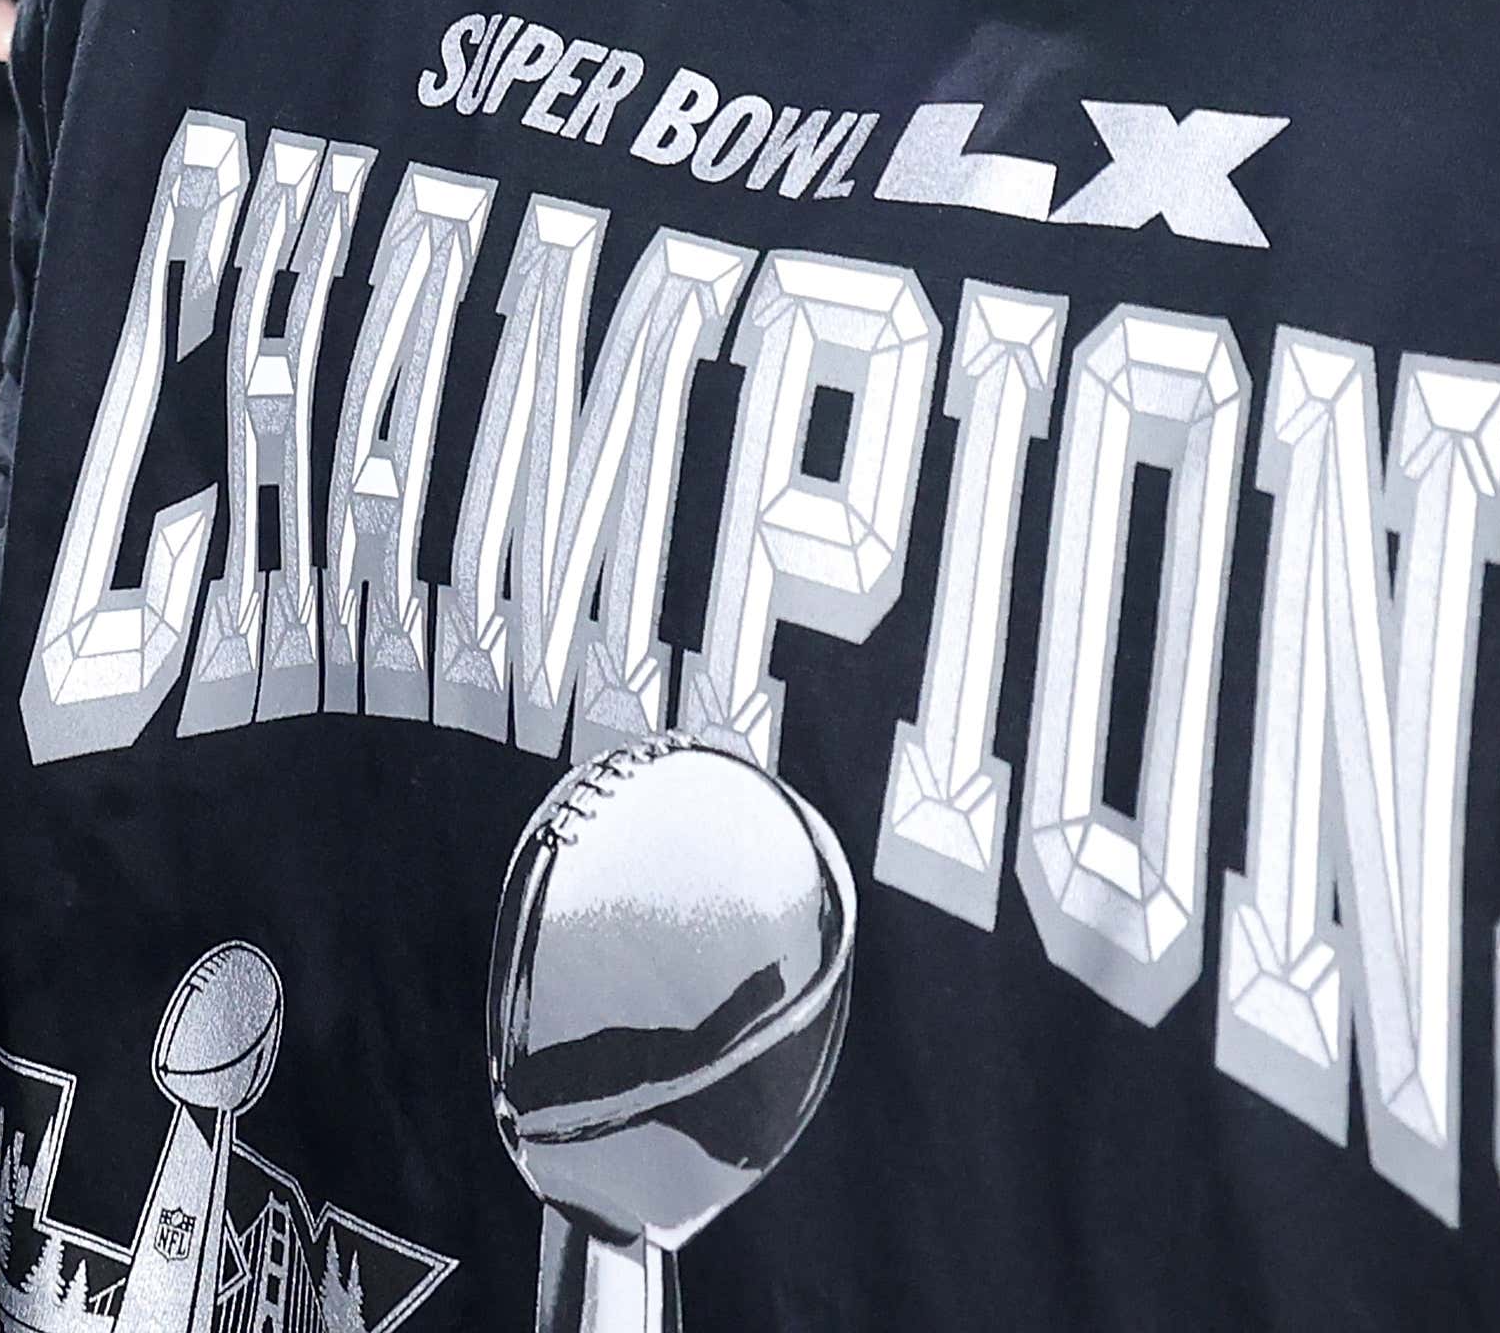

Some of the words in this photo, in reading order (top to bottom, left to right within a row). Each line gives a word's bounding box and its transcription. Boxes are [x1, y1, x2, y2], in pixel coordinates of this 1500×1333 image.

[417, 12, 646, 146] SUPER
[630, 65, 880, 200] BOWL
[873, 98, 1291, 248] LX
[157, 1225, 188, 1256] NFL
